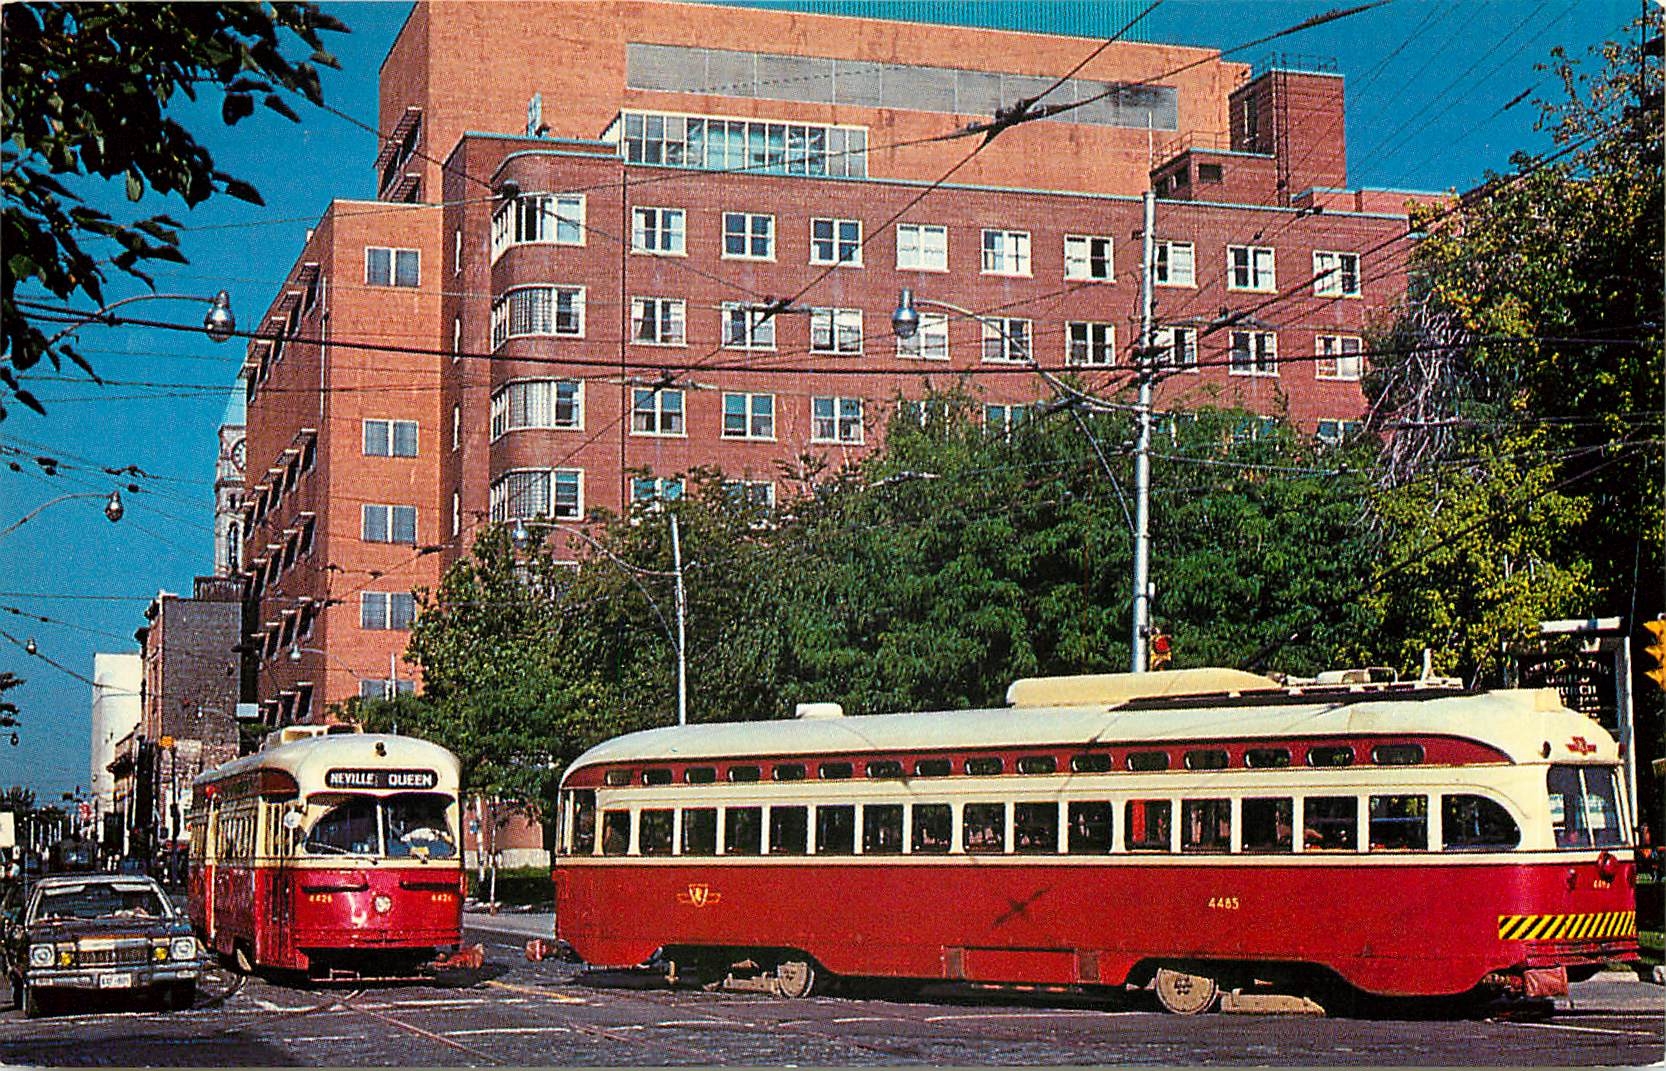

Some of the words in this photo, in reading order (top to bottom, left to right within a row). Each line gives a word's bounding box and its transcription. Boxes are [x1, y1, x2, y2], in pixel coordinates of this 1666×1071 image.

[330, 772, 374, 786] NEVILLE
[388, 773, 432, 787] QUEEN
[1208, 897, 1239, 910] 4485
